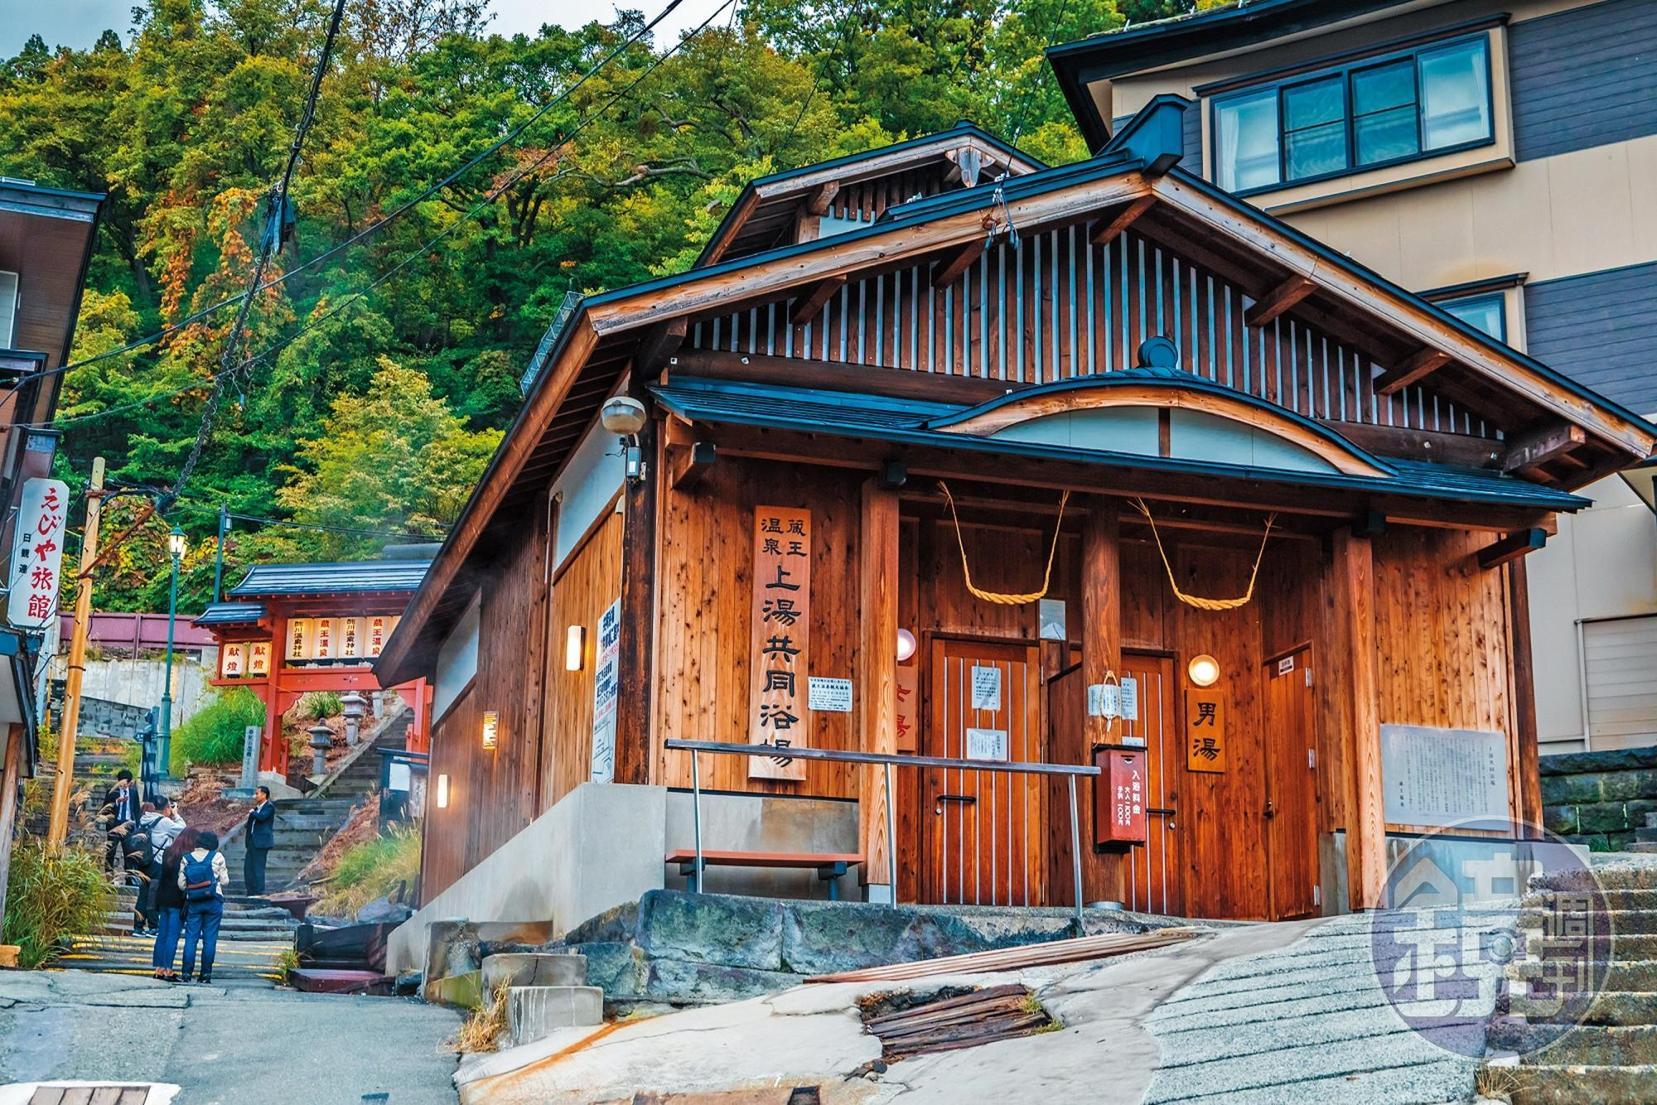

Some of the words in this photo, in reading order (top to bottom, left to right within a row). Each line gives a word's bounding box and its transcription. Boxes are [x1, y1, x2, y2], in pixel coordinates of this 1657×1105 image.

[27, 487, 61, 619] えびや旅館
[761, 518, 784, 556] 温泉
[786, 519, 807, 557] 蔵王
[760, 565, 801, 768] 上湯共同浴場
[1193, 702, 1221, 761] 男湯
